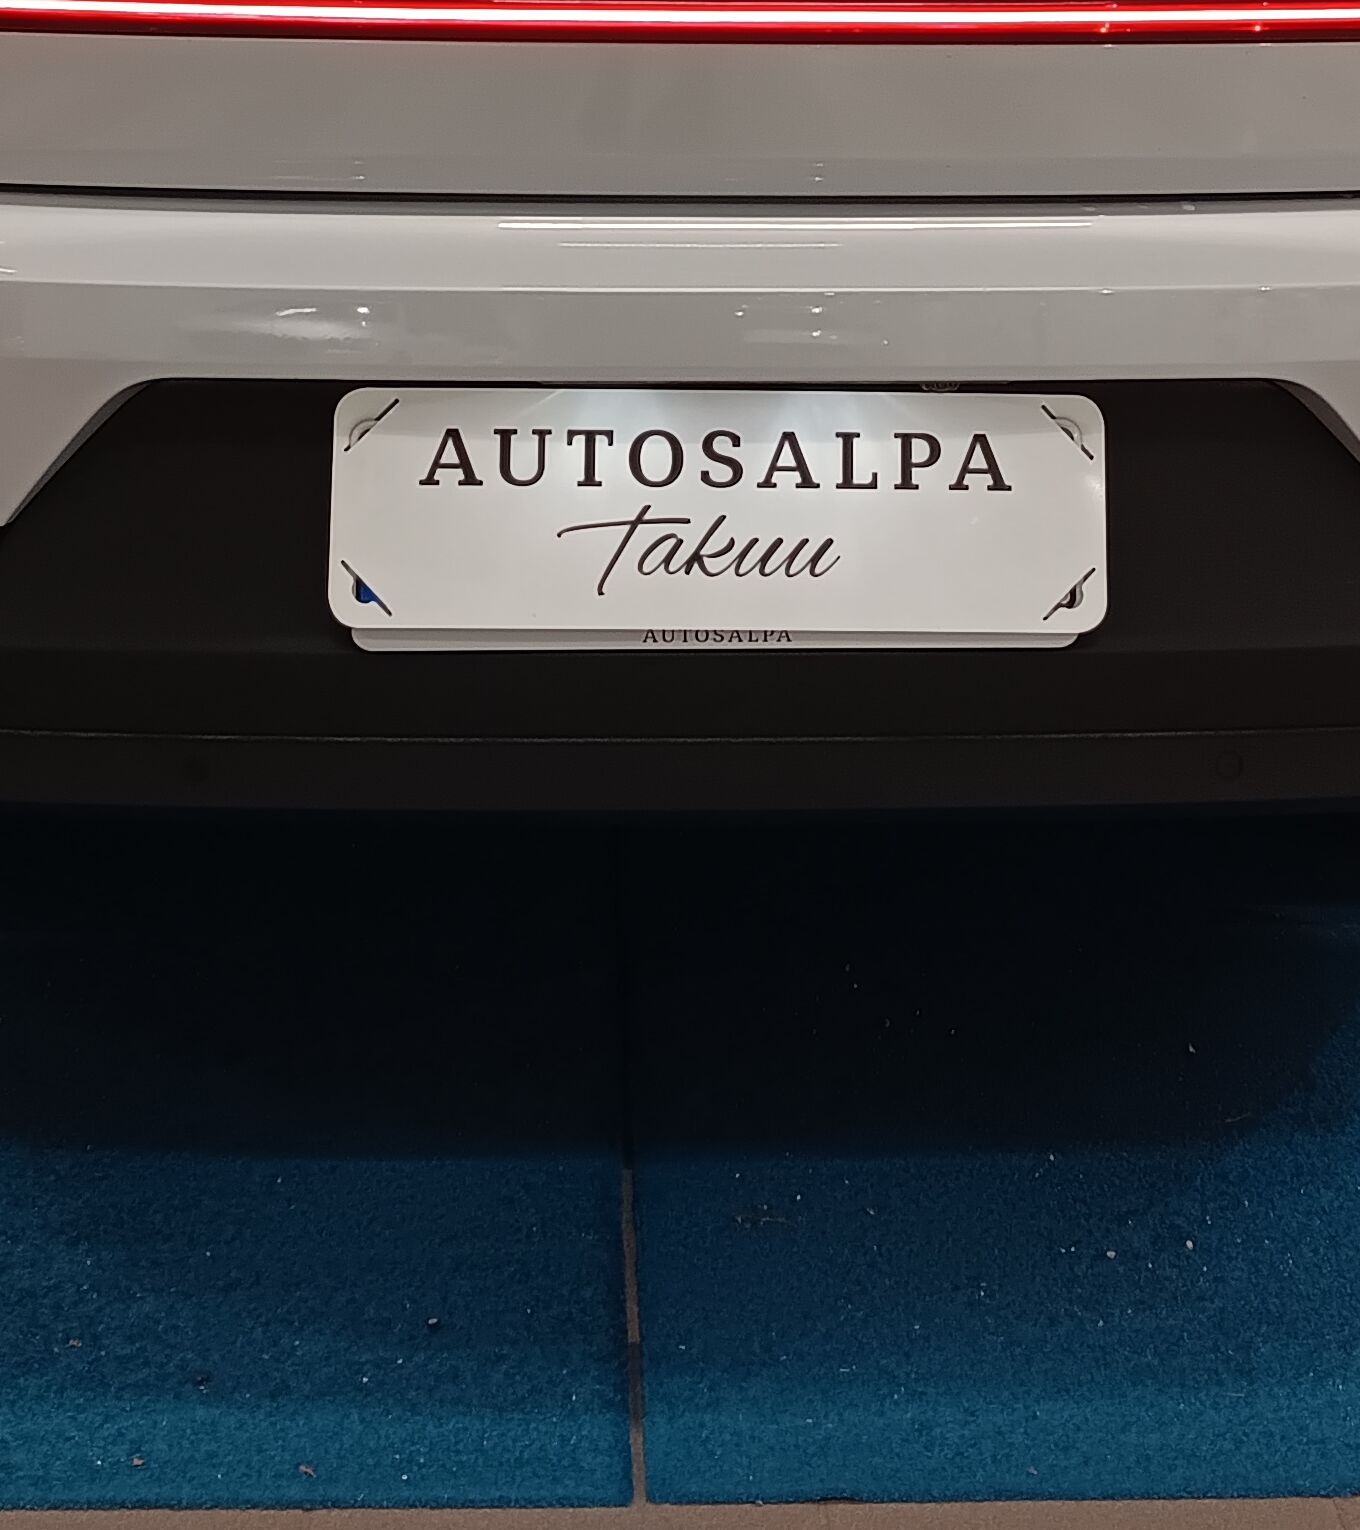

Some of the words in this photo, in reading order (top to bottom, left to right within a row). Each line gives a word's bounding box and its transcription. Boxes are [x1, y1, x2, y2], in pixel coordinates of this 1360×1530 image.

[418, 427, 1013, 492] AUTOSALPA
[557, 504, 841, 596] Takuu
[642, 629, 793, 643] AUTOSALPA
